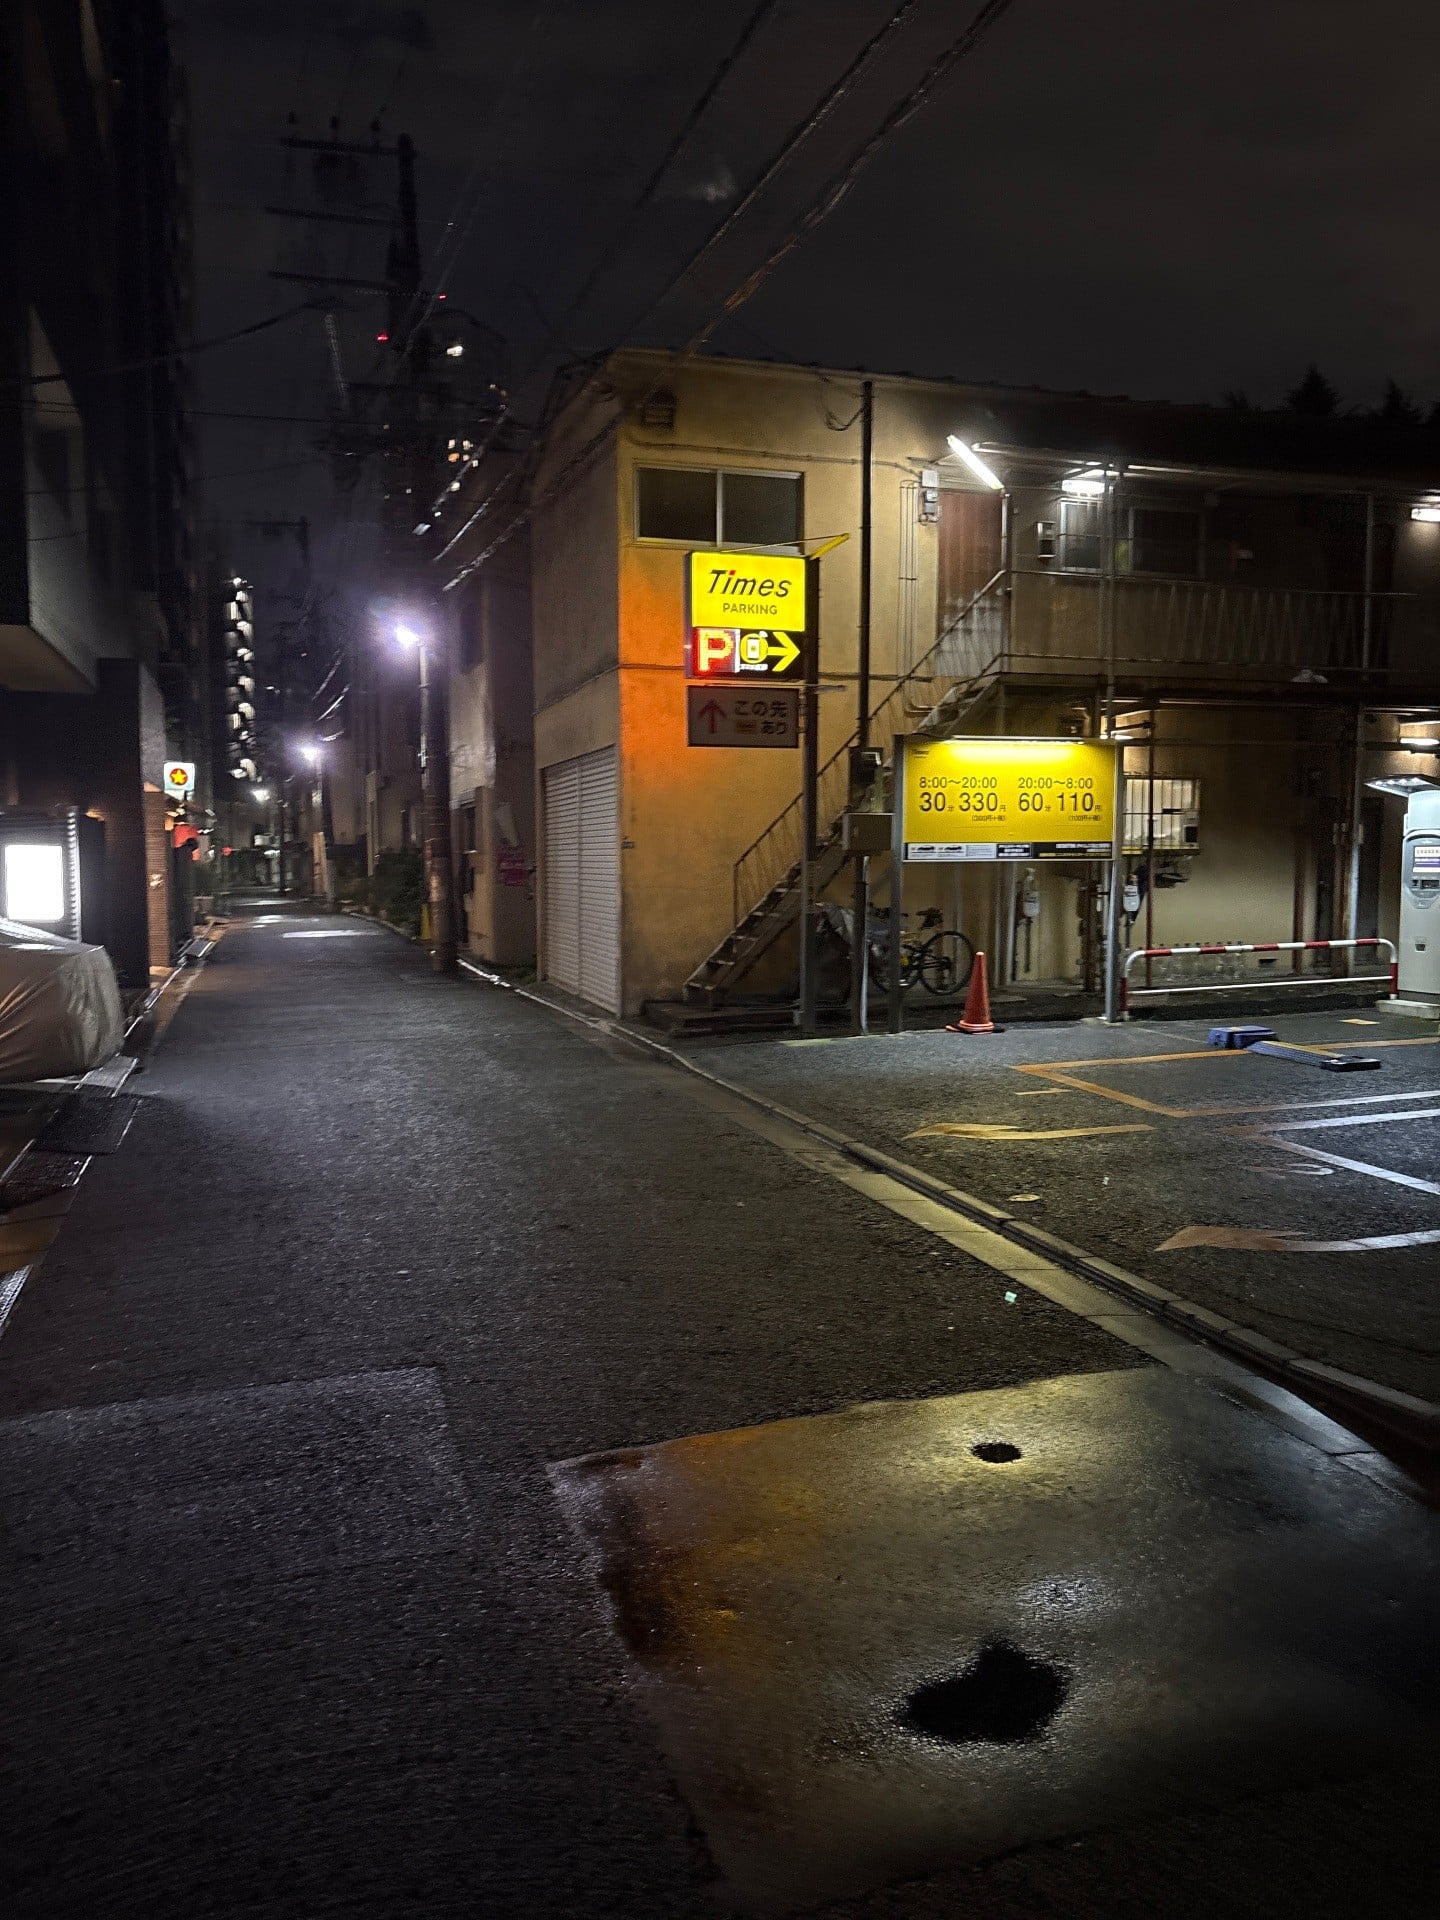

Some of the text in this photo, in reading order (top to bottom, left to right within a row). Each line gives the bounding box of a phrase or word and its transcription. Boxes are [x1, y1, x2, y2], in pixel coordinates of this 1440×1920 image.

[708, 569, 792, 598] Times
[722, 602, 778, 615] PARKING
[698, 628, 734, 672] P
[734, 700, 787, 719] この先
[761, 720, 787, 735] あり
